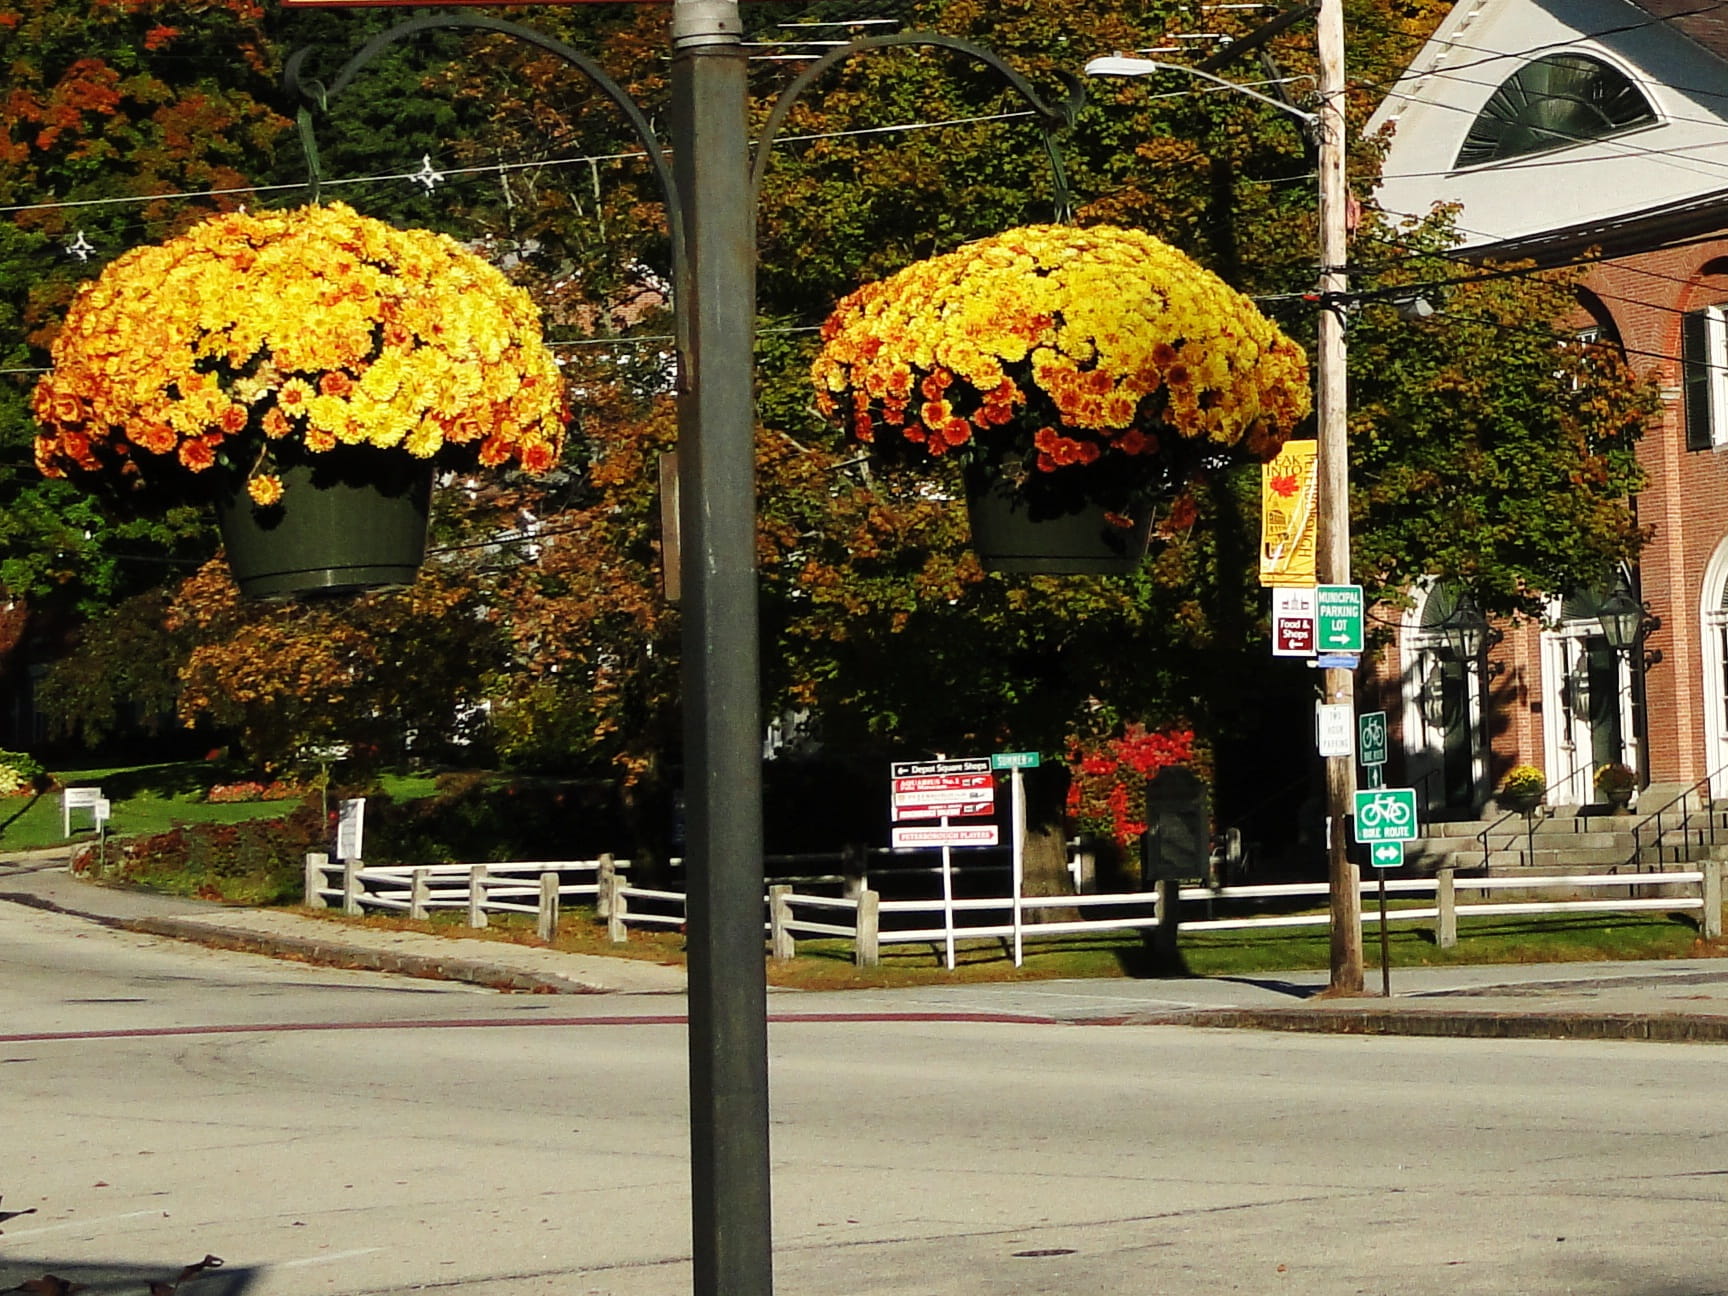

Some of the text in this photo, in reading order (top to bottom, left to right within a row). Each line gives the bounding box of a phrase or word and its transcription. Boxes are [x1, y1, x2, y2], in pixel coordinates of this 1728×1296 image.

[1267, 464, 1302, 477] INTO
[1319, 591, 1360, 604] MUNICIPAL
[1320, 604, 1359, 617] PARKING
[1280, 619, 1301, 629] Food
[1331, 619, 1348, 632] LOT
[1282, 629, 1308, 640] Shops
[911, 762, 988, 775] Depot Square Shops
[1362, 826, 1410, 839] BIKE ROUTE
